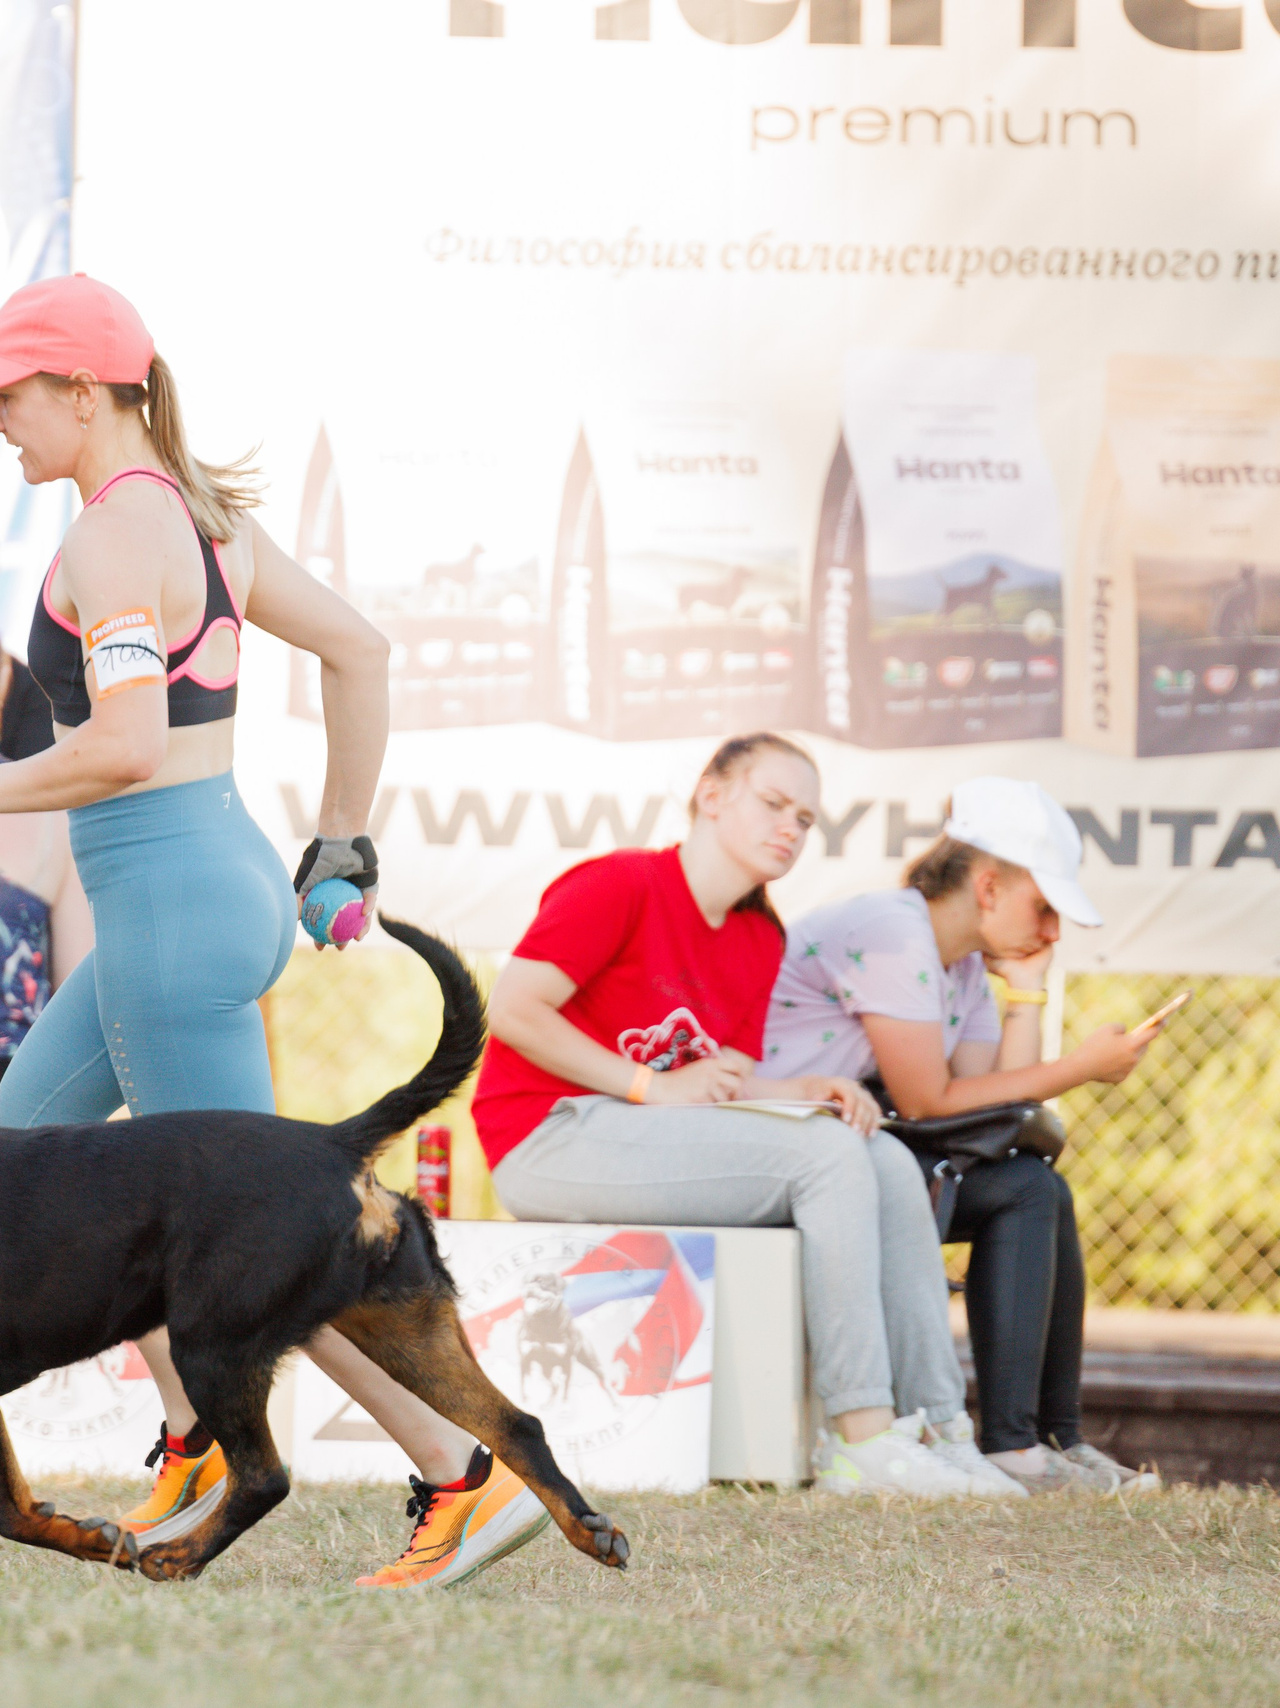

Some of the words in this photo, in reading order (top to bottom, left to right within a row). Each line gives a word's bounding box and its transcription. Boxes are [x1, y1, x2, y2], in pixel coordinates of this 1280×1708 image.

[750, 96, 1139, 151] premium
[423, 225, 710, 280] Философия
[720, 228, 1221, 288] сбалансированного
[893, 453, 1022, 484] Hanta
[91, 612, 146, 643] PROFIFEED
